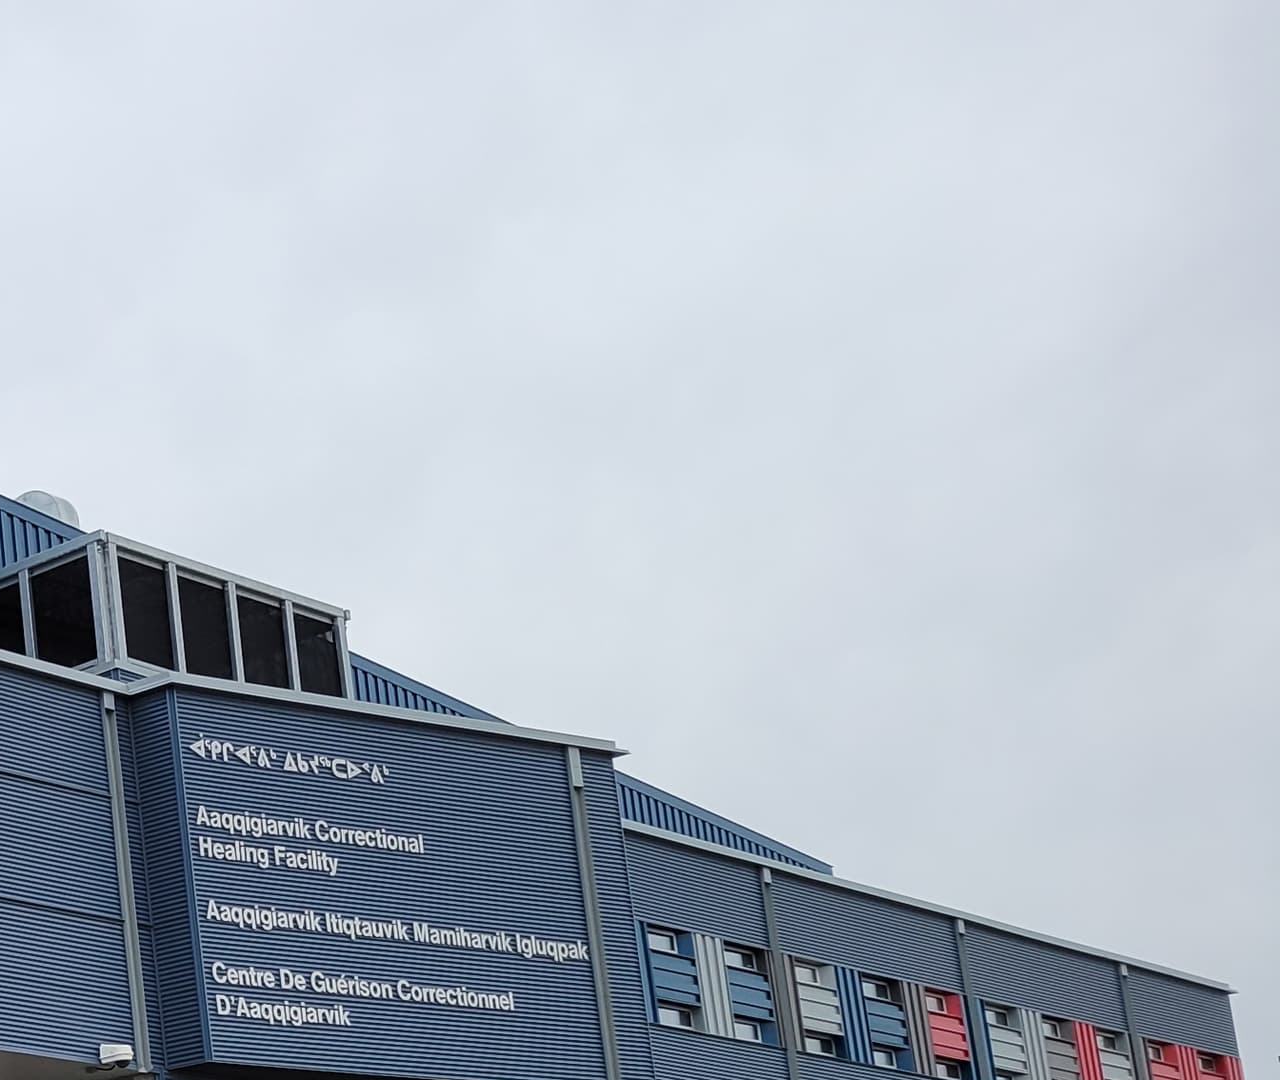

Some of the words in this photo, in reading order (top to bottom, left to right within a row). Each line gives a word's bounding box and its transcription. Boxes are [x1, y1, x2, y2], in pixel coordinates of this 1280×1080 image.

[196, 805, 312, 839] Aaqqigiarvik
[315, 820, 424, 854] Correctional
[198, 836, 269, 869] Healing
[273, 845, 339, 876] Facility
[206, 899, 322, 932] Aaqqigiarvik
[325, 912, 409, 941] Itiqtauvik
[412, 921, 513, 953] Mamiharvik
[516, 933, 589, 962] Igluqpak
[211, 961, 276, 988] Centre
[279, 968, 307, 991] De
[310, 971, 393, 999] Guérison
[396, 979, 515, 1011] Correctionnel
[215, 994, 352, 1026] D'Aaqqigiarvik
